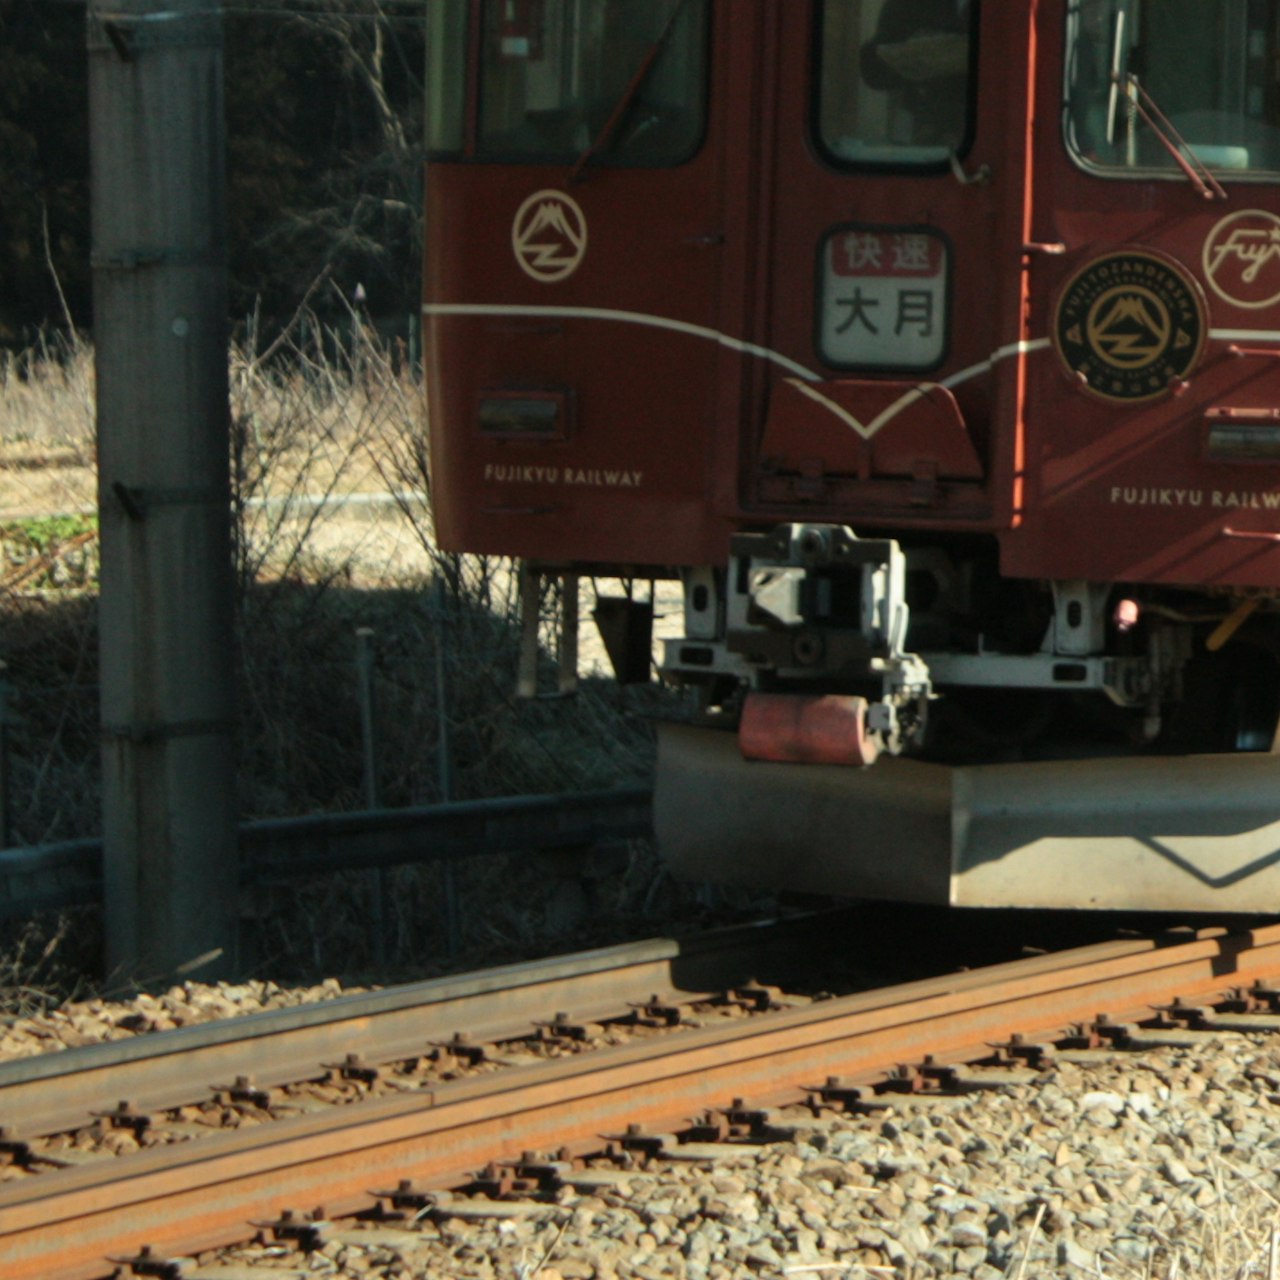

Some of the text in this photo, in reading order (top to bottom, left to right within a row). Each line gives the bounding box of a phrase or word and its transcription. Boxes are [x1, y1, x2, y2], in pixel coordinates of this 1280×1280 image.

[844, 231, 931, 270] 快速
[835, 285, 932, 338] 大月
[484, 463, 643, 487] FUJIKYU RAILWAY
[1110, 486, 1202, 506] FUJIKYU
